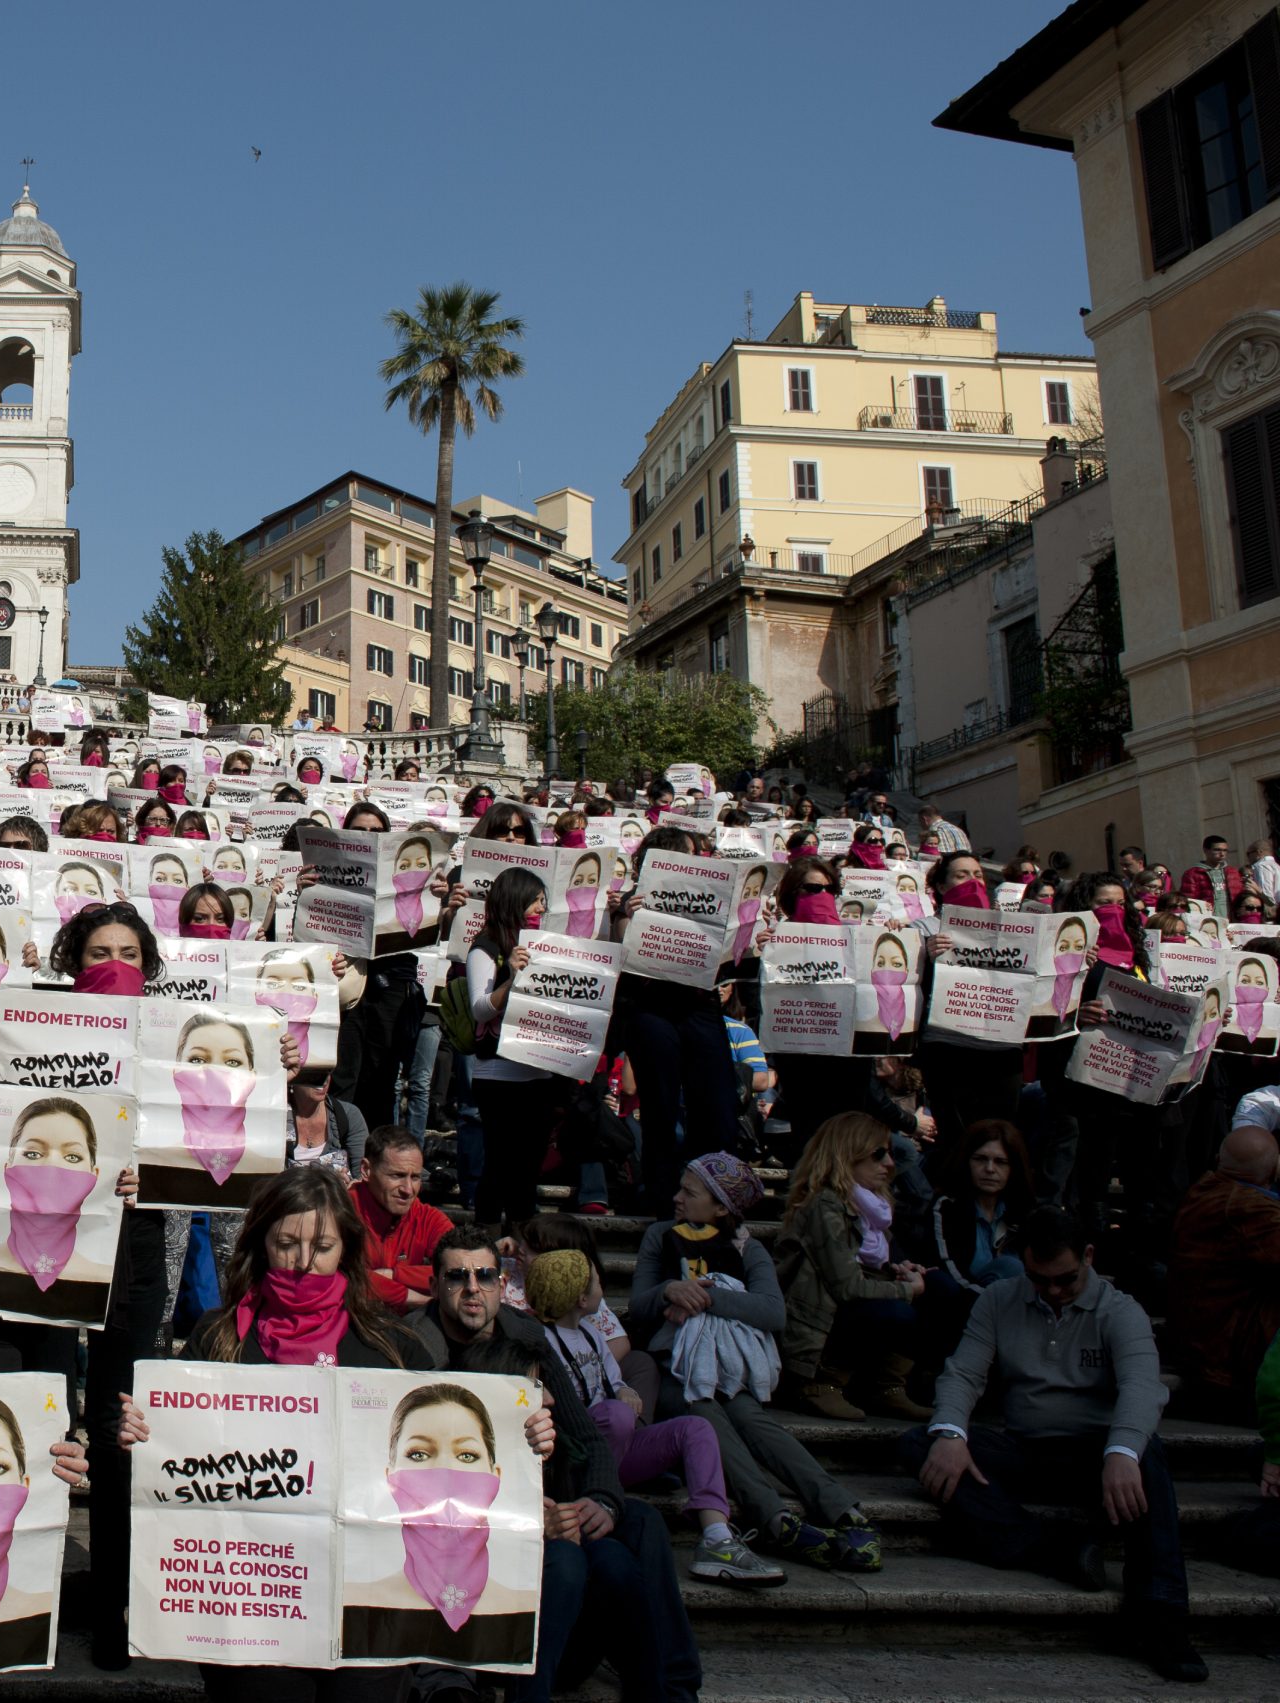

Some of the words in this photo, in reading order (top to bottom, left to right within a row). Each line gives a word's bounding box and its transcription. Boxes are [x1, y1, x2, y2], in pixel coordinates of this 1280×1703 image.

[305, 838, 371, 853] ENDOMETRIOSI
[472, 850, 549, 868] ENDOMETRIOSI
[651, 861, 729, 881] ENDOMETRIOSI
[651, 890, 715, 902] ROMPIAMO
[653, 901, 721, 915] SILENZIO!
[949, 917, 1034, 934] ENDOMETRIOSI
[642, 942, 661, 950] NON
[663, 945, 685, 955] VUOL
[687, 950, 707, 959] DIRE
[770, 936, 847, 947] ENDOMETRIOSI
[528, 941, 613, 964] ENDOMETRIOSI
[638, 950, 655, 958] CHE
[656, 953, 675, 961] NON
[677, 957, 707, 968] ESISTA.
[1160, 952, 1216, 964] ENDOMETRIOSI
[530, 973, 598, 987] ROMPIAMO
[954, 982, 977, 991] SOLO
[979, 986, 1014, 996] PERCHÉ
[947, 990, 966, 998] NON
[980, 994, 1019, 1005] CONOSCI
[949, 999, 968, 1007] NON
[970, 1002, 992, 1011] VUOL
[994, 1005, 1015, 1013] DIRE
[1108, 980, 1191, 1014] ENDOMETRIOSI
[4, 1009, 128, 1030] ENDOMETRIOSI
[806, 1010, 841, 1018] CONOSCI
[945, 1008, 961, 1016] CHE
[963, 1010, 982, 1018] NON
[984, 1013, 1015, 1022] ESISTA.
[10, 1051, 110, 1073] ROMPIAMO
[18, 1058, 121, 1088] SILENZIO!
[149, 1391, 319, 1414] ENDOMETRIOSI
[162, 1448, 298, 1479] ROMPIAMO
[175, 1461, 314, 1503] SILENZIO!
[173, 1538, 221, 1554] SOLO
[225, 1540, 295, 1559] PERCHÉ
[160, 1558, 199, 1573] NON
[203, 1560, 226, 1574] LA
[230, 1561, 308, 1581] CONOSCI
[166, 1578, 205, 1594] NON
[209, 1581, 257, 1596] VUOL
[261, 1583, 302, 1600] DIRE
[159, 1598, 194, 1614] CHE
[198, 1601, 237, 1617] NON
[242, 1603, 307, 1621] ESISTA.
[186, 1634, 280, 1647] www.apeonlus.com
